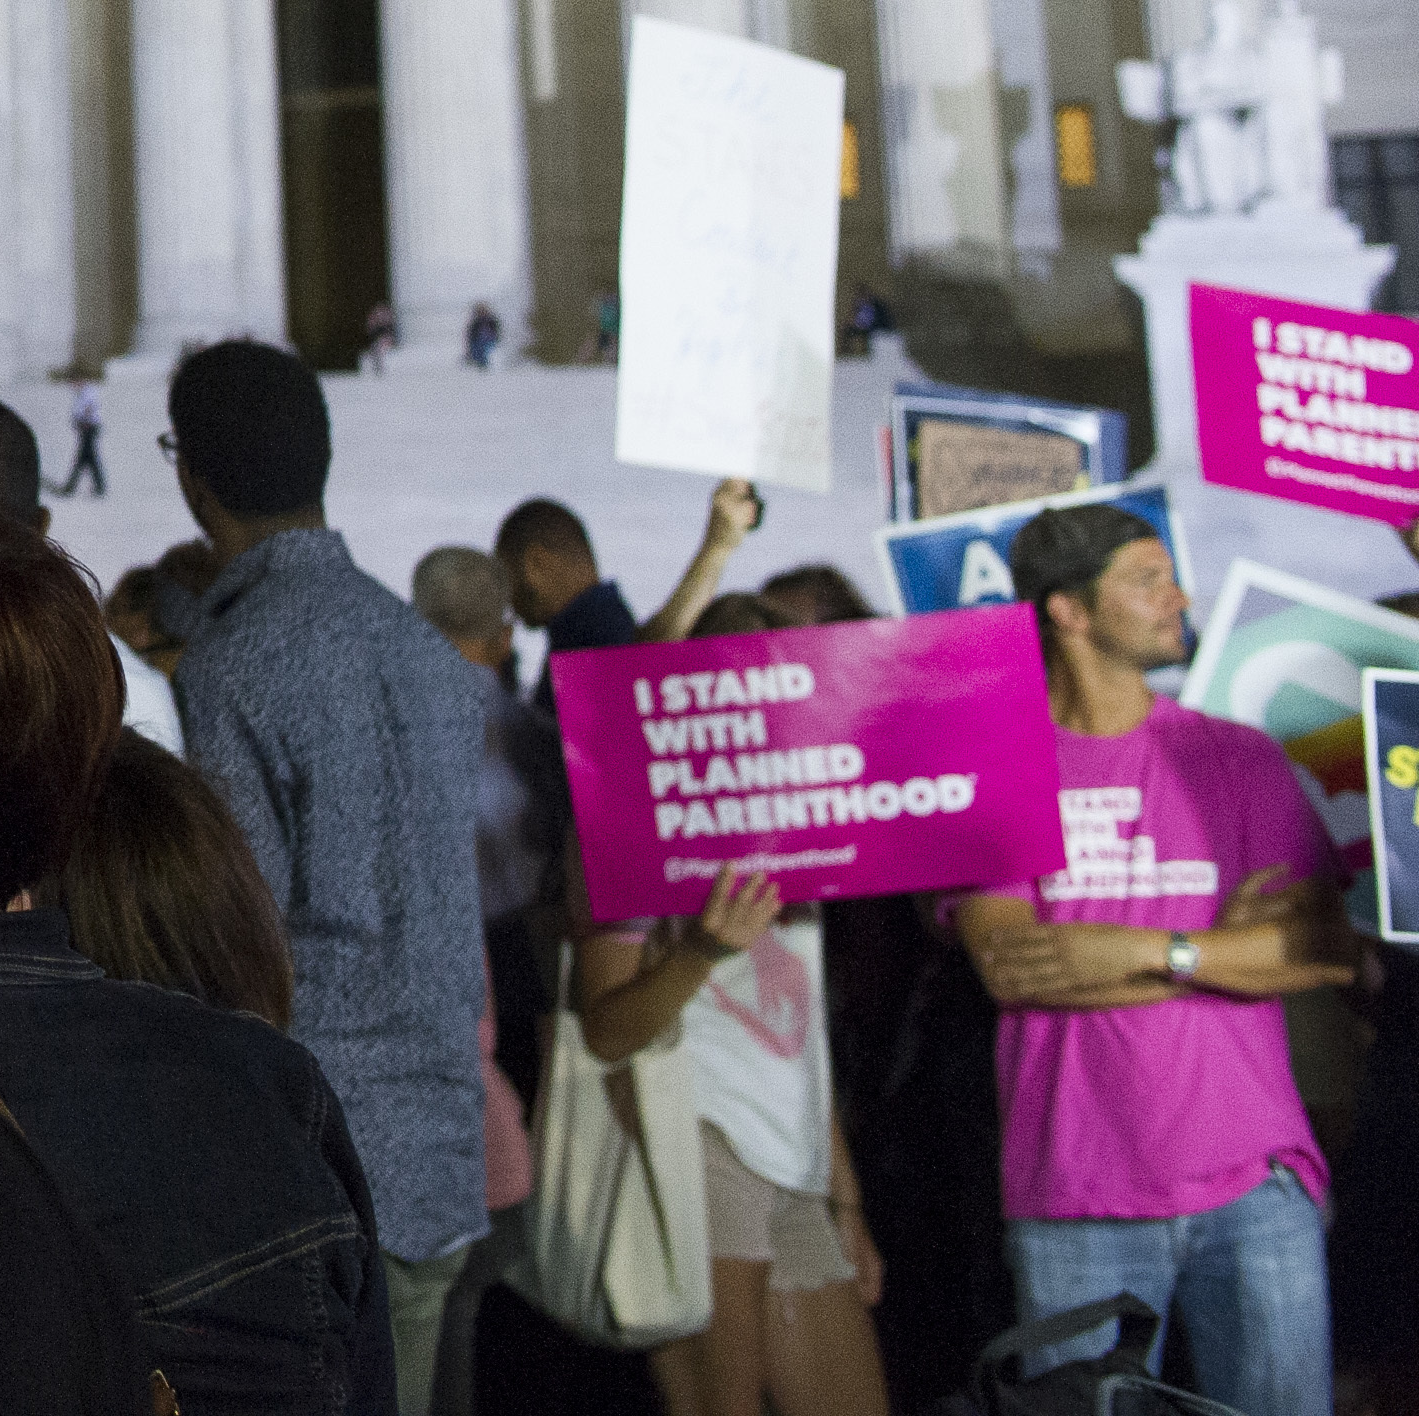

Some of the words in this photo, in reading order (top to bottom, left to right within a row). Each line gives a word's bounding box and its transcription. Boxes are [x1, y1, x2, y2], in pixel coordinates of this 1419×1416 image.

[1275, 321, 1414, 376] STAND
[1255, 350, 1367, 402] WITH
[632, 677, 655, 716] I
[660, 662, 817, 715] STAND
[641, 710, 767, 757] WITH
[646, 742, 866, 799] PLANNED
[653, 772, 977, 841] PARENTHOOD
